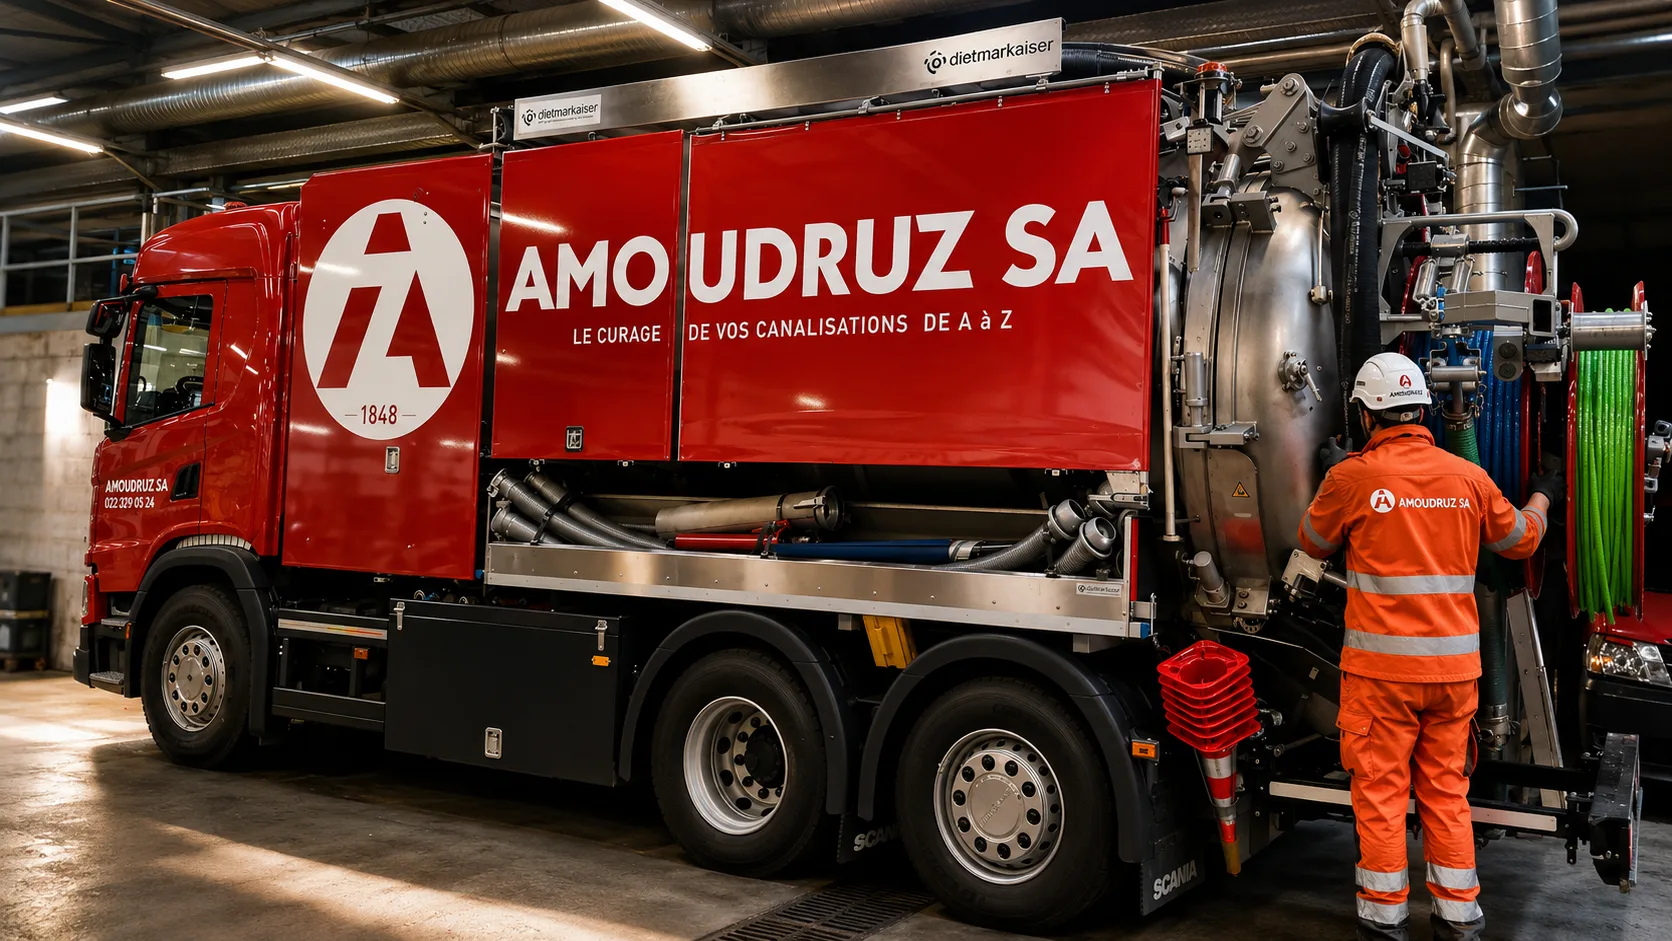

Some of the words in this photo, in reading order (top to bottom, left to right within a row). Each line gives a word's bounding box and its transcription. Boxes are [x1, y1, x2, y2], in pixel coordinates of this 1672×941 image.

[950, 39, 1054, 66] dietmarkaiser
[538, 103, 598, 120] dietmarkaiser
[505, 210, 975, 312] AMOUDRUZ
[1001, 200, 1134, 288] SA
[573, 328, 592, 345] LE
[597, 325, 661, 344] CURAGE
[689, 323, 710, 341] DE
[716, 321, 749, 340] VOS
[756, 314, 908, 338] CANALISATIONS
[924, 312, 950, 332] DE
[958, 311, 972, 331] A
[980, 310, 991, 330] à
[1000, 309, 1013, 329] Z
[360, 404, 398, 425] 1848
[105, 478, 155, 493] AMOUDRUZ
[155, 478, 168, 492] SA
[104, 497, 118, 509] 022
[134, 496, 144, 508] 05
[145, 496, 155, 509] 24
[1398, 497, 1457, 508] AMOUDRUZ
[1459, 497, 1470, 509] SA
[853, 823, 901, 852] SCAN
[1153, 860, 1198, 900] SCANIA
